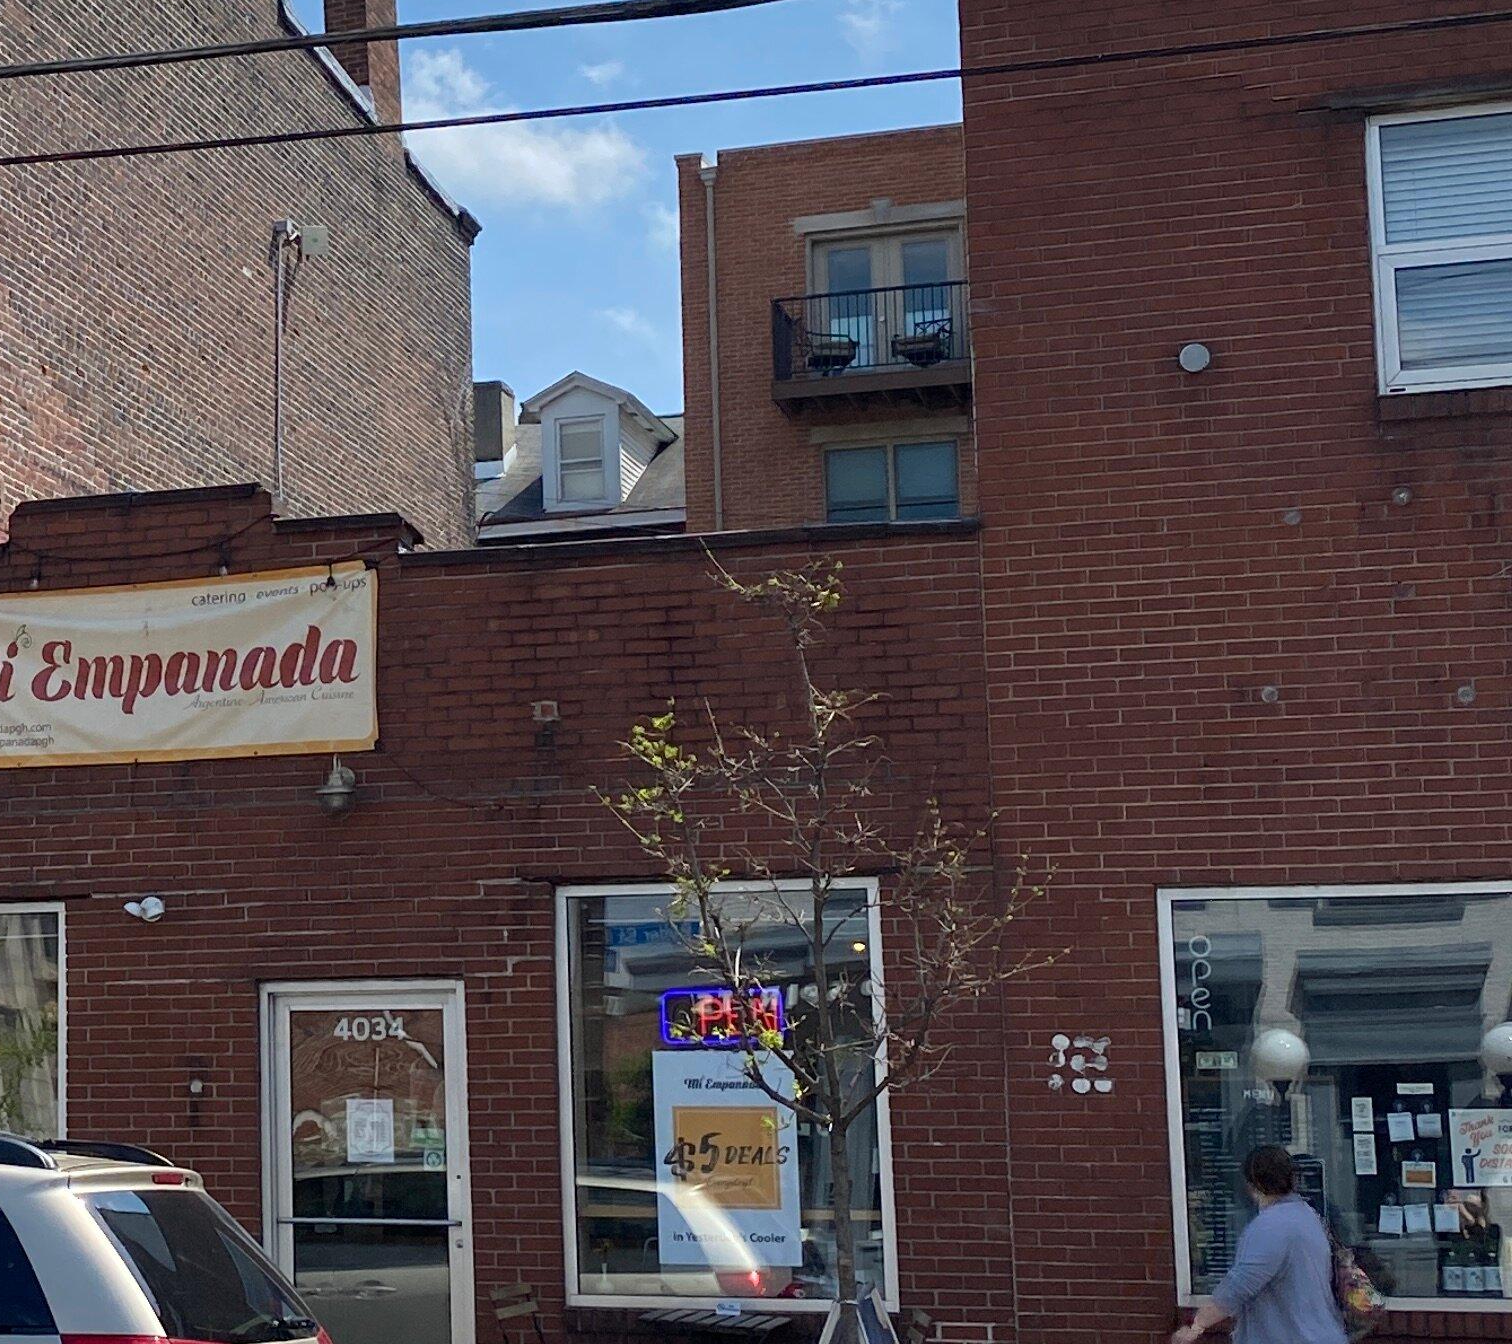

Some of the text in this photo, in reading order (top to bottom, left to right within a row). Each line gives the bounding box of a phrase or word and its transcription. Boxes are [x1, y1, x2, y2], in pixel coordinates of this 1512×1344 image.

[191, 590, 246, 606] catering
[256, 585, 299, 600] events
[31, 624, 360, 715] Empanada
[184, 686, 355, 712] Argentine American Cuisine
[333, 1016, 405, 1042] 4034
[683, 1075, 762, 1092] Mi Empanad
[1459, 1115, 1494, 1136] Thank
[724, 1145, 791, 1166] DEALS
[749, 1232, 787, 1244] Cooler
